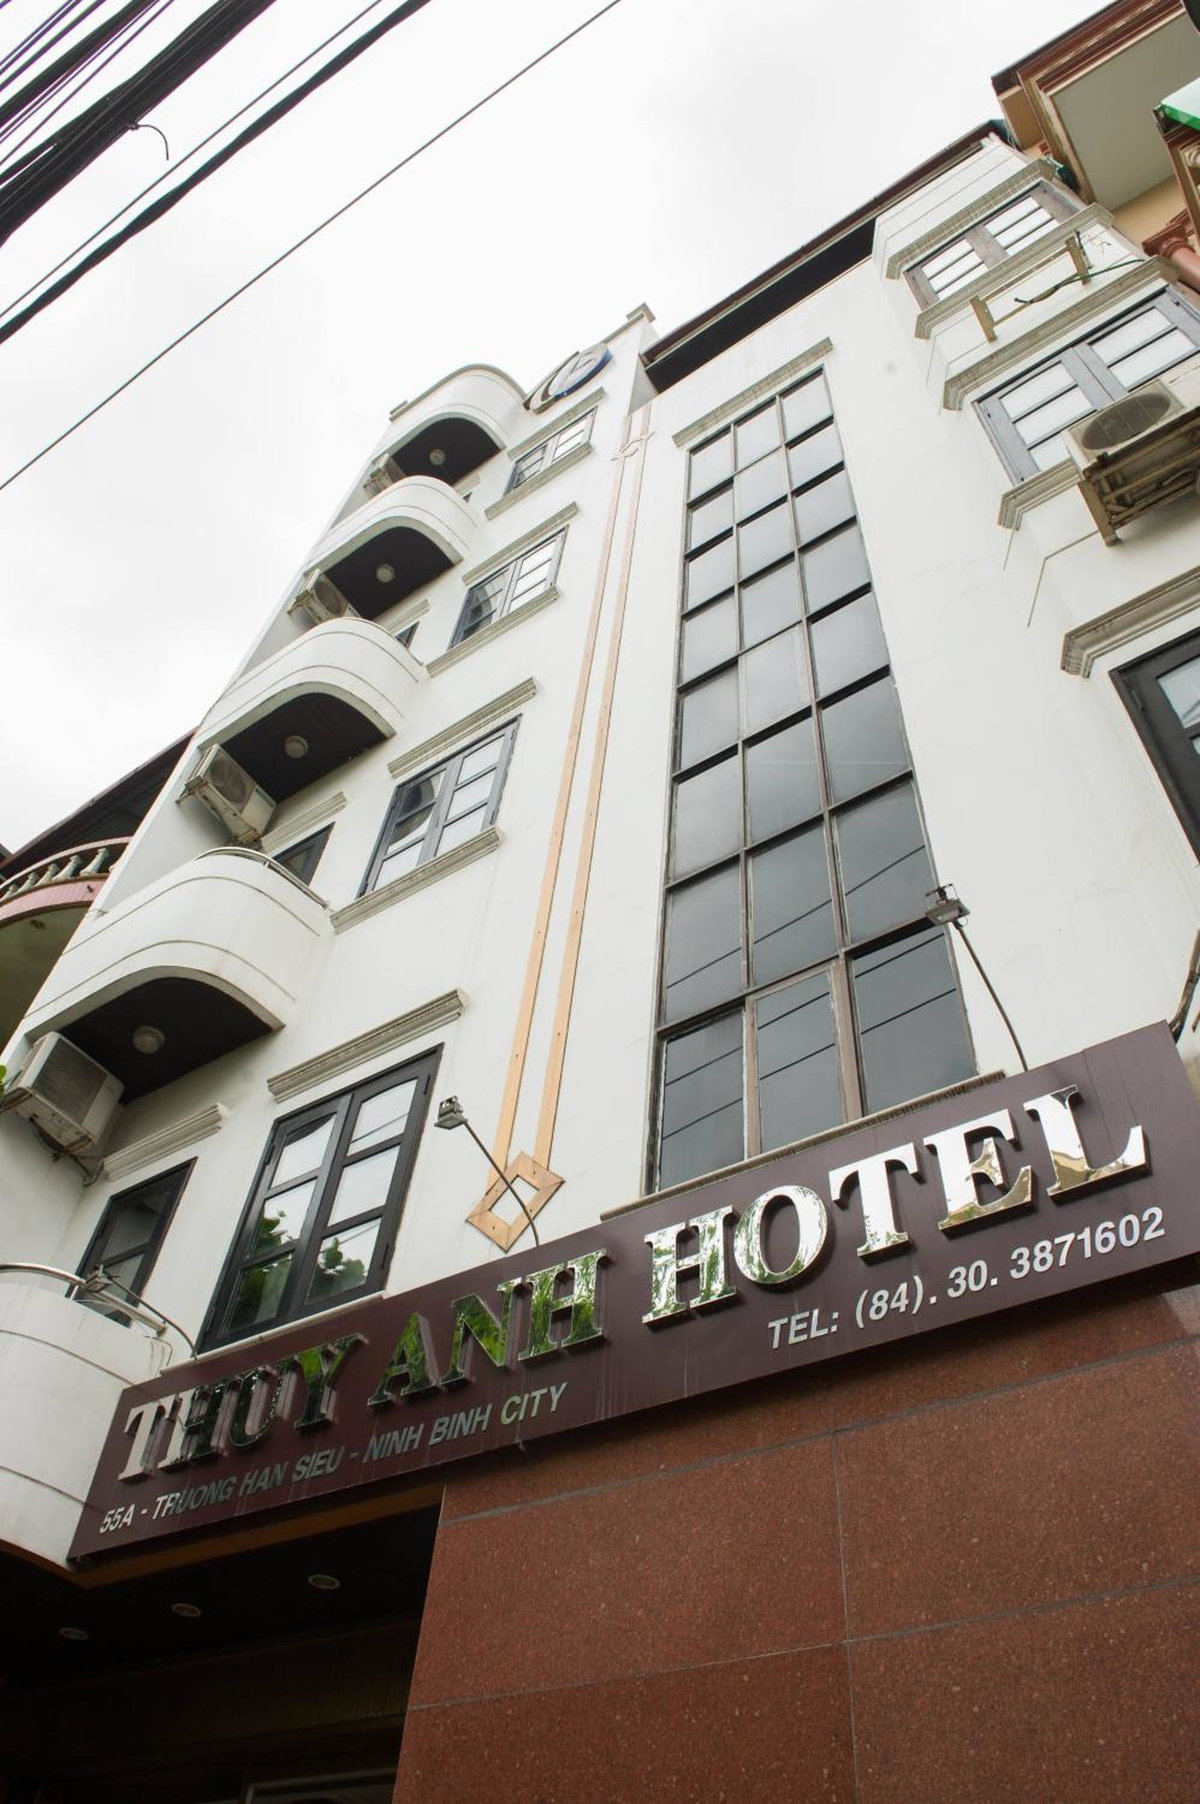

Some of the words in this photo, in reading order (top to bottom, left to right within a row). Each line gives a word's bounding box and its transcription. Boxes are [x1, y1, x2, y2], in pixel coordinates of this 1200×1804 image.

[117, 1332, 369, 1483] THUY
[367, 1248, 610, 1407] ANH
[642, 1084, 1149, 1325] HOTEL
[768, 1308, 839, 1349] TEL:
[947, 1259, 998, 1299] 30.
[1010, 1206, 1166, 1280] 3871602
[99, 1503, 136, 1535] 55A
[152, 1480, 235, 1521] TRUONG
[240, 1465, 289, 1495] HAN
[294, 1447, 345, 1480] SIEU
[363, 1423, 426, 1463] NINH
[428, 1403, 491, 1447] BINH
[499, 1382, 569, 1425] CITY
